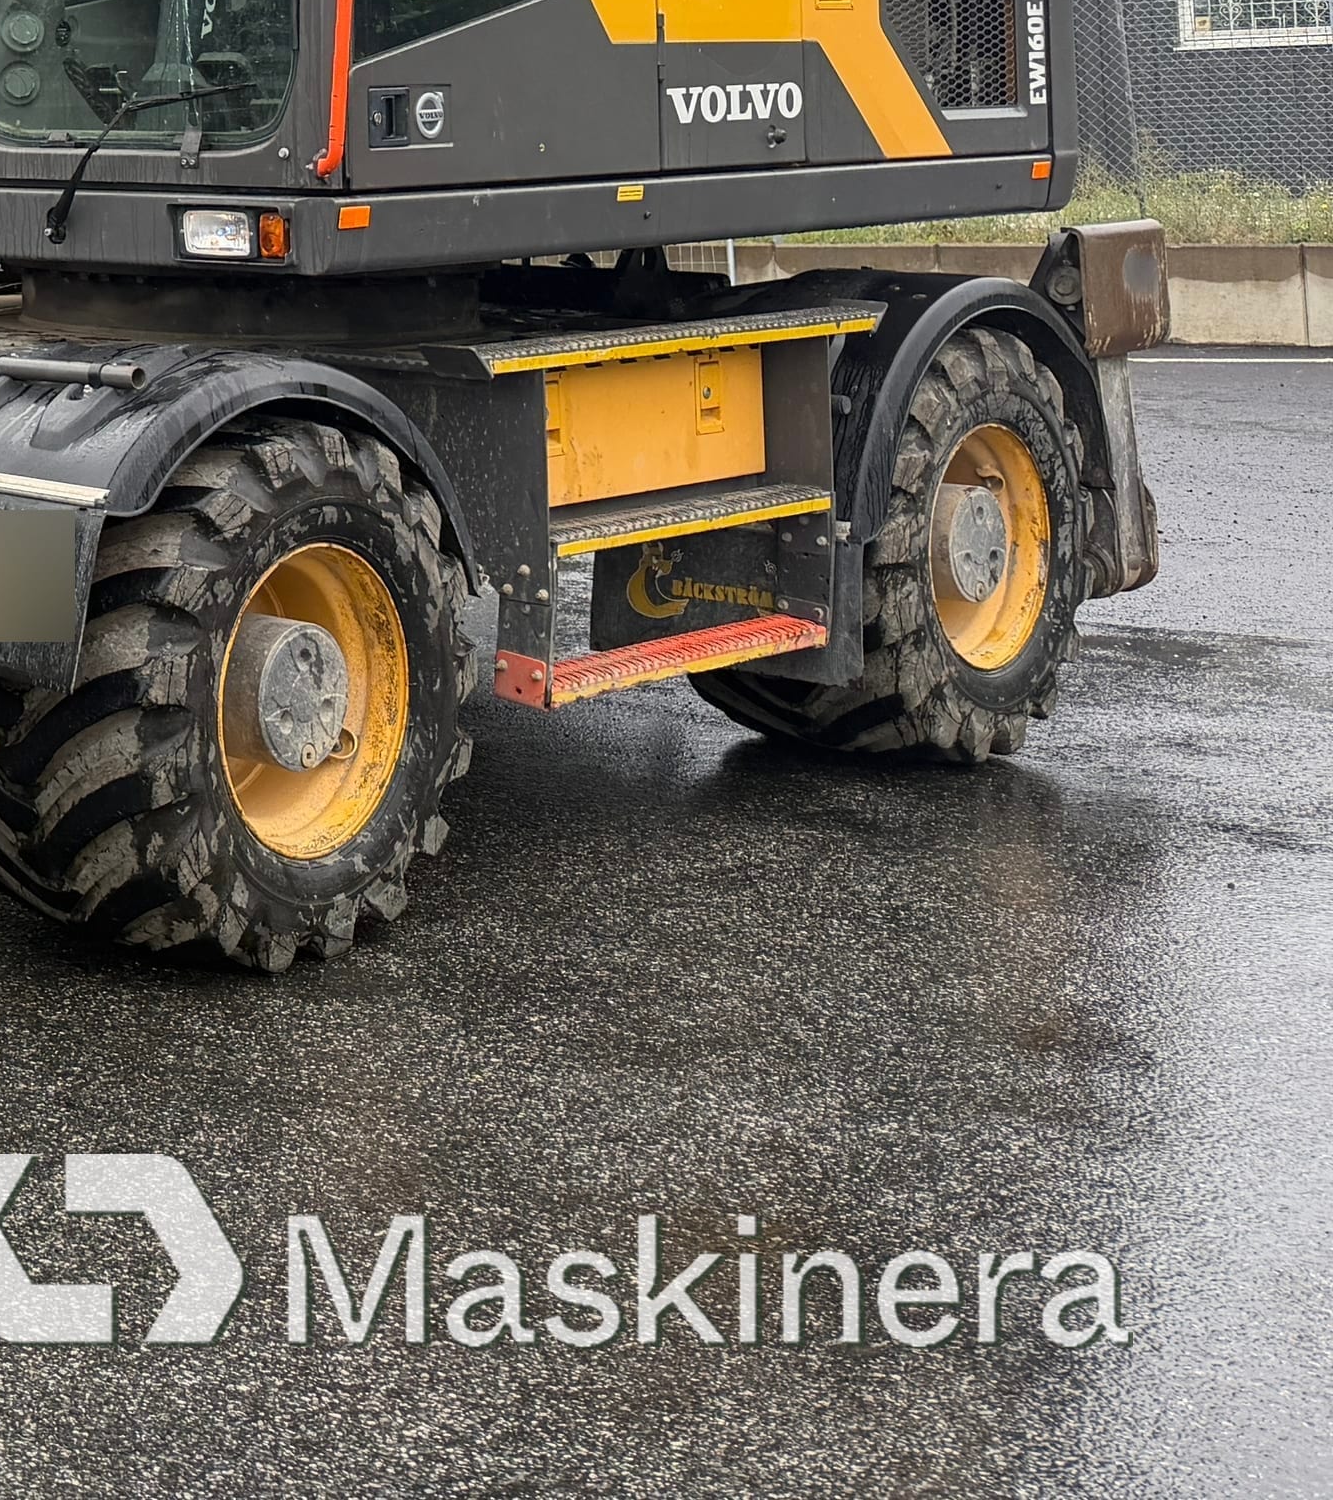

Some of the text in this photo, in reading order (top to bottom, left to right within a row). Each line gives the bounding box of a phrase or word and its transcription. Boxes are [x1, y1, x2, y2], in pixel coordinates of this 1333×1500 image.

[1026, 1, 1047, 105] EW160E
[419, 111, 444, 120] VOLVO
[666, 81, 803, 124] VOLVO
